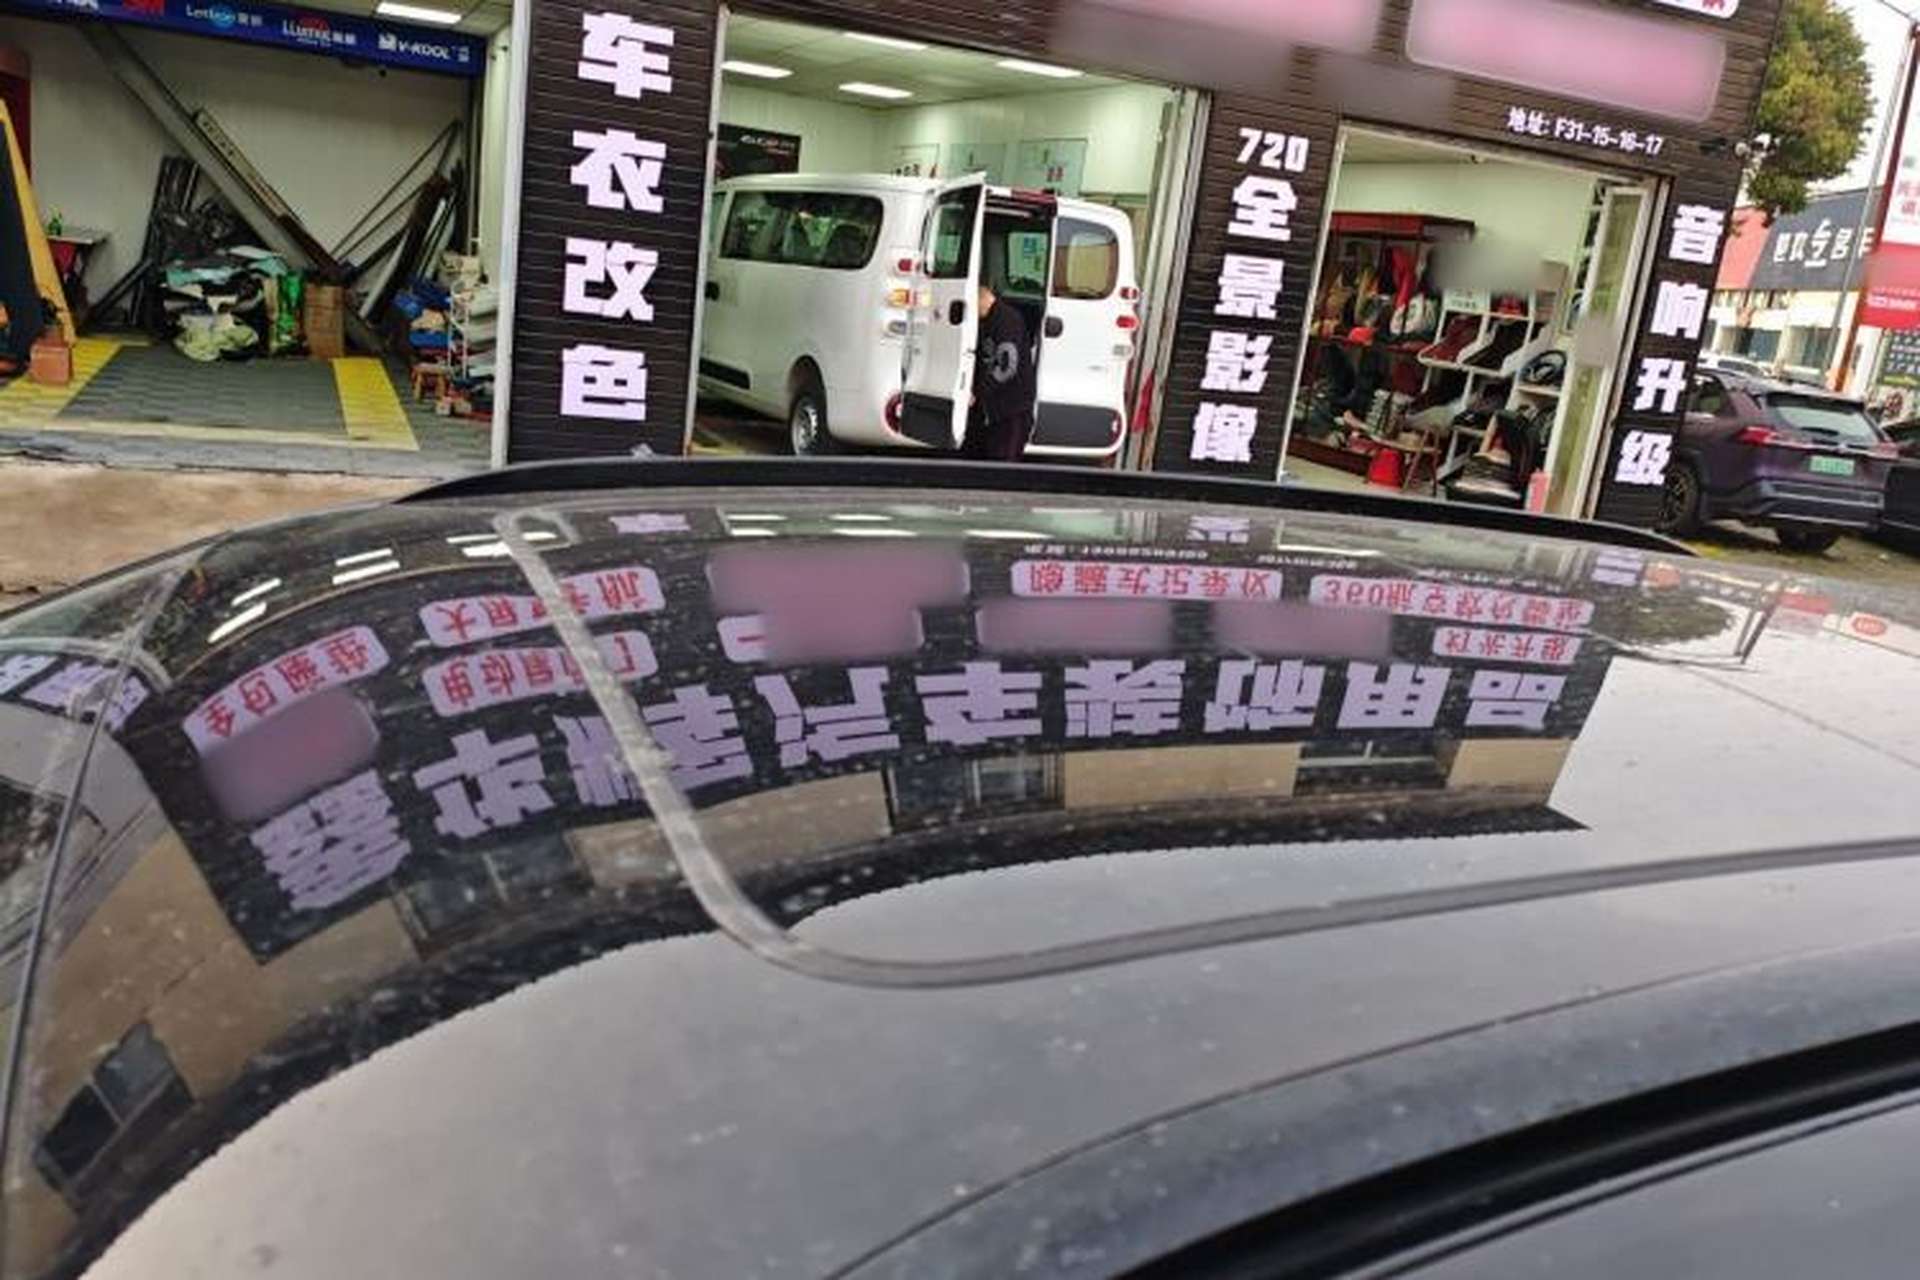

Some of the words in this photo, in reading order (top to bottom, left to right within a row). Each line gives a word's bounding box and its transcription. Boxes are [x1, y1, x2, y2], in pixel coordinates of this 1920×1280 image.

[559, 12, 675, 421] 车衣改色
[1236, 127, 1310, 173] 720
[1190, 175, 1298, 464] 全景影像
[1616, 203, 1725, 487] 音响升级
